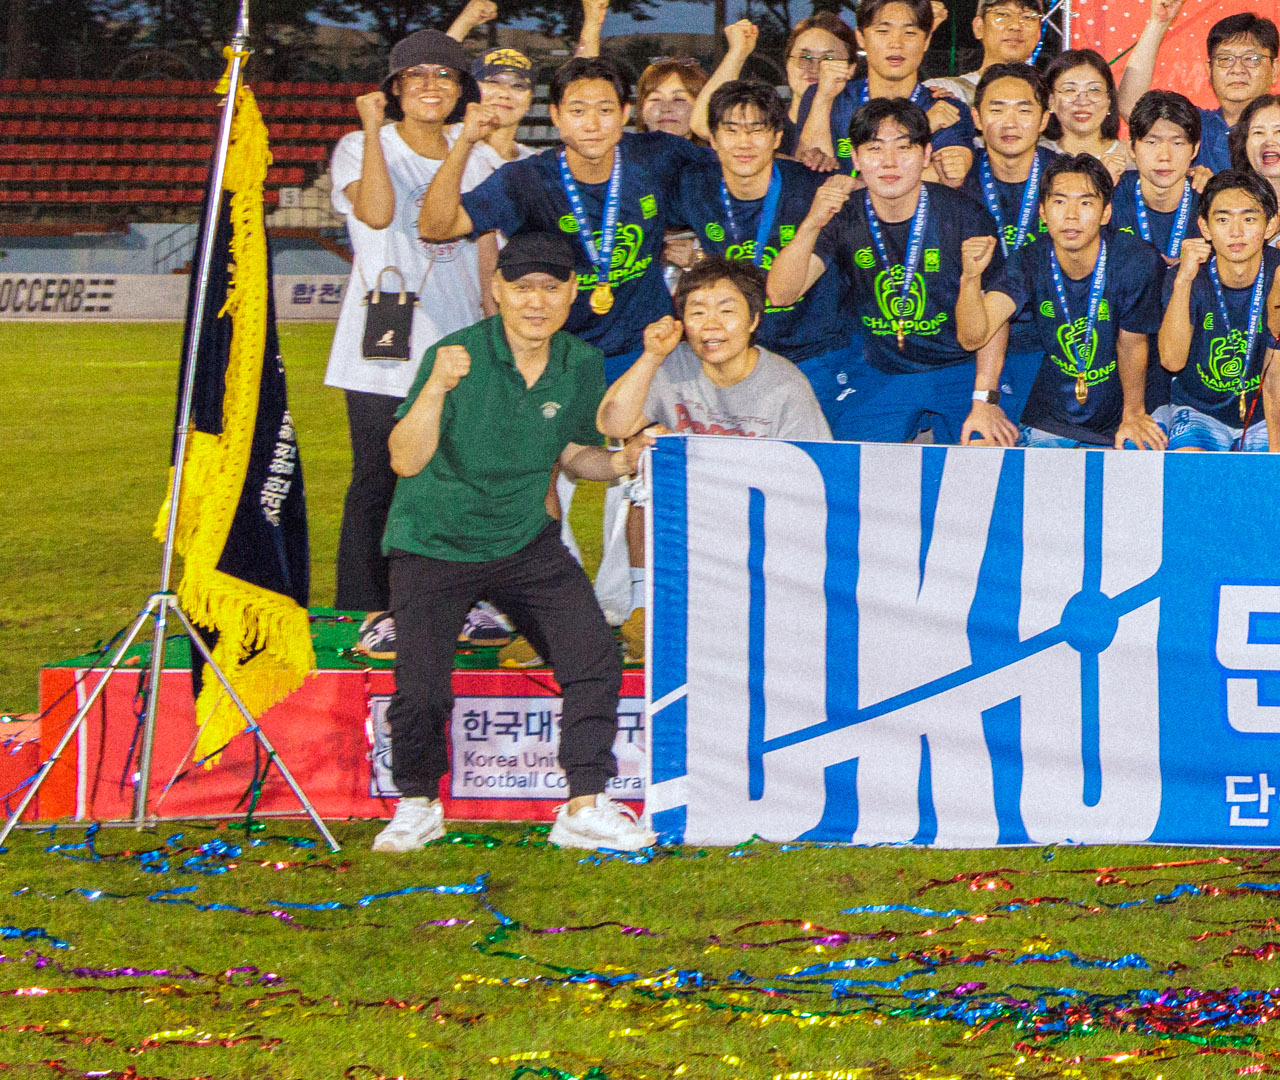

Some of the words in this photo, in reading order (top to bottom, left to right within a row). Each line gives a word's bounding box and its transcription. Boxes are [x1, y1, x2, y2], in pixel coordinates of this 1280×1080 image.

[687, 436, 1164, 848] DKU
[464, 751, 517, 767] Korea
[464, 771, 536, 788] Football
